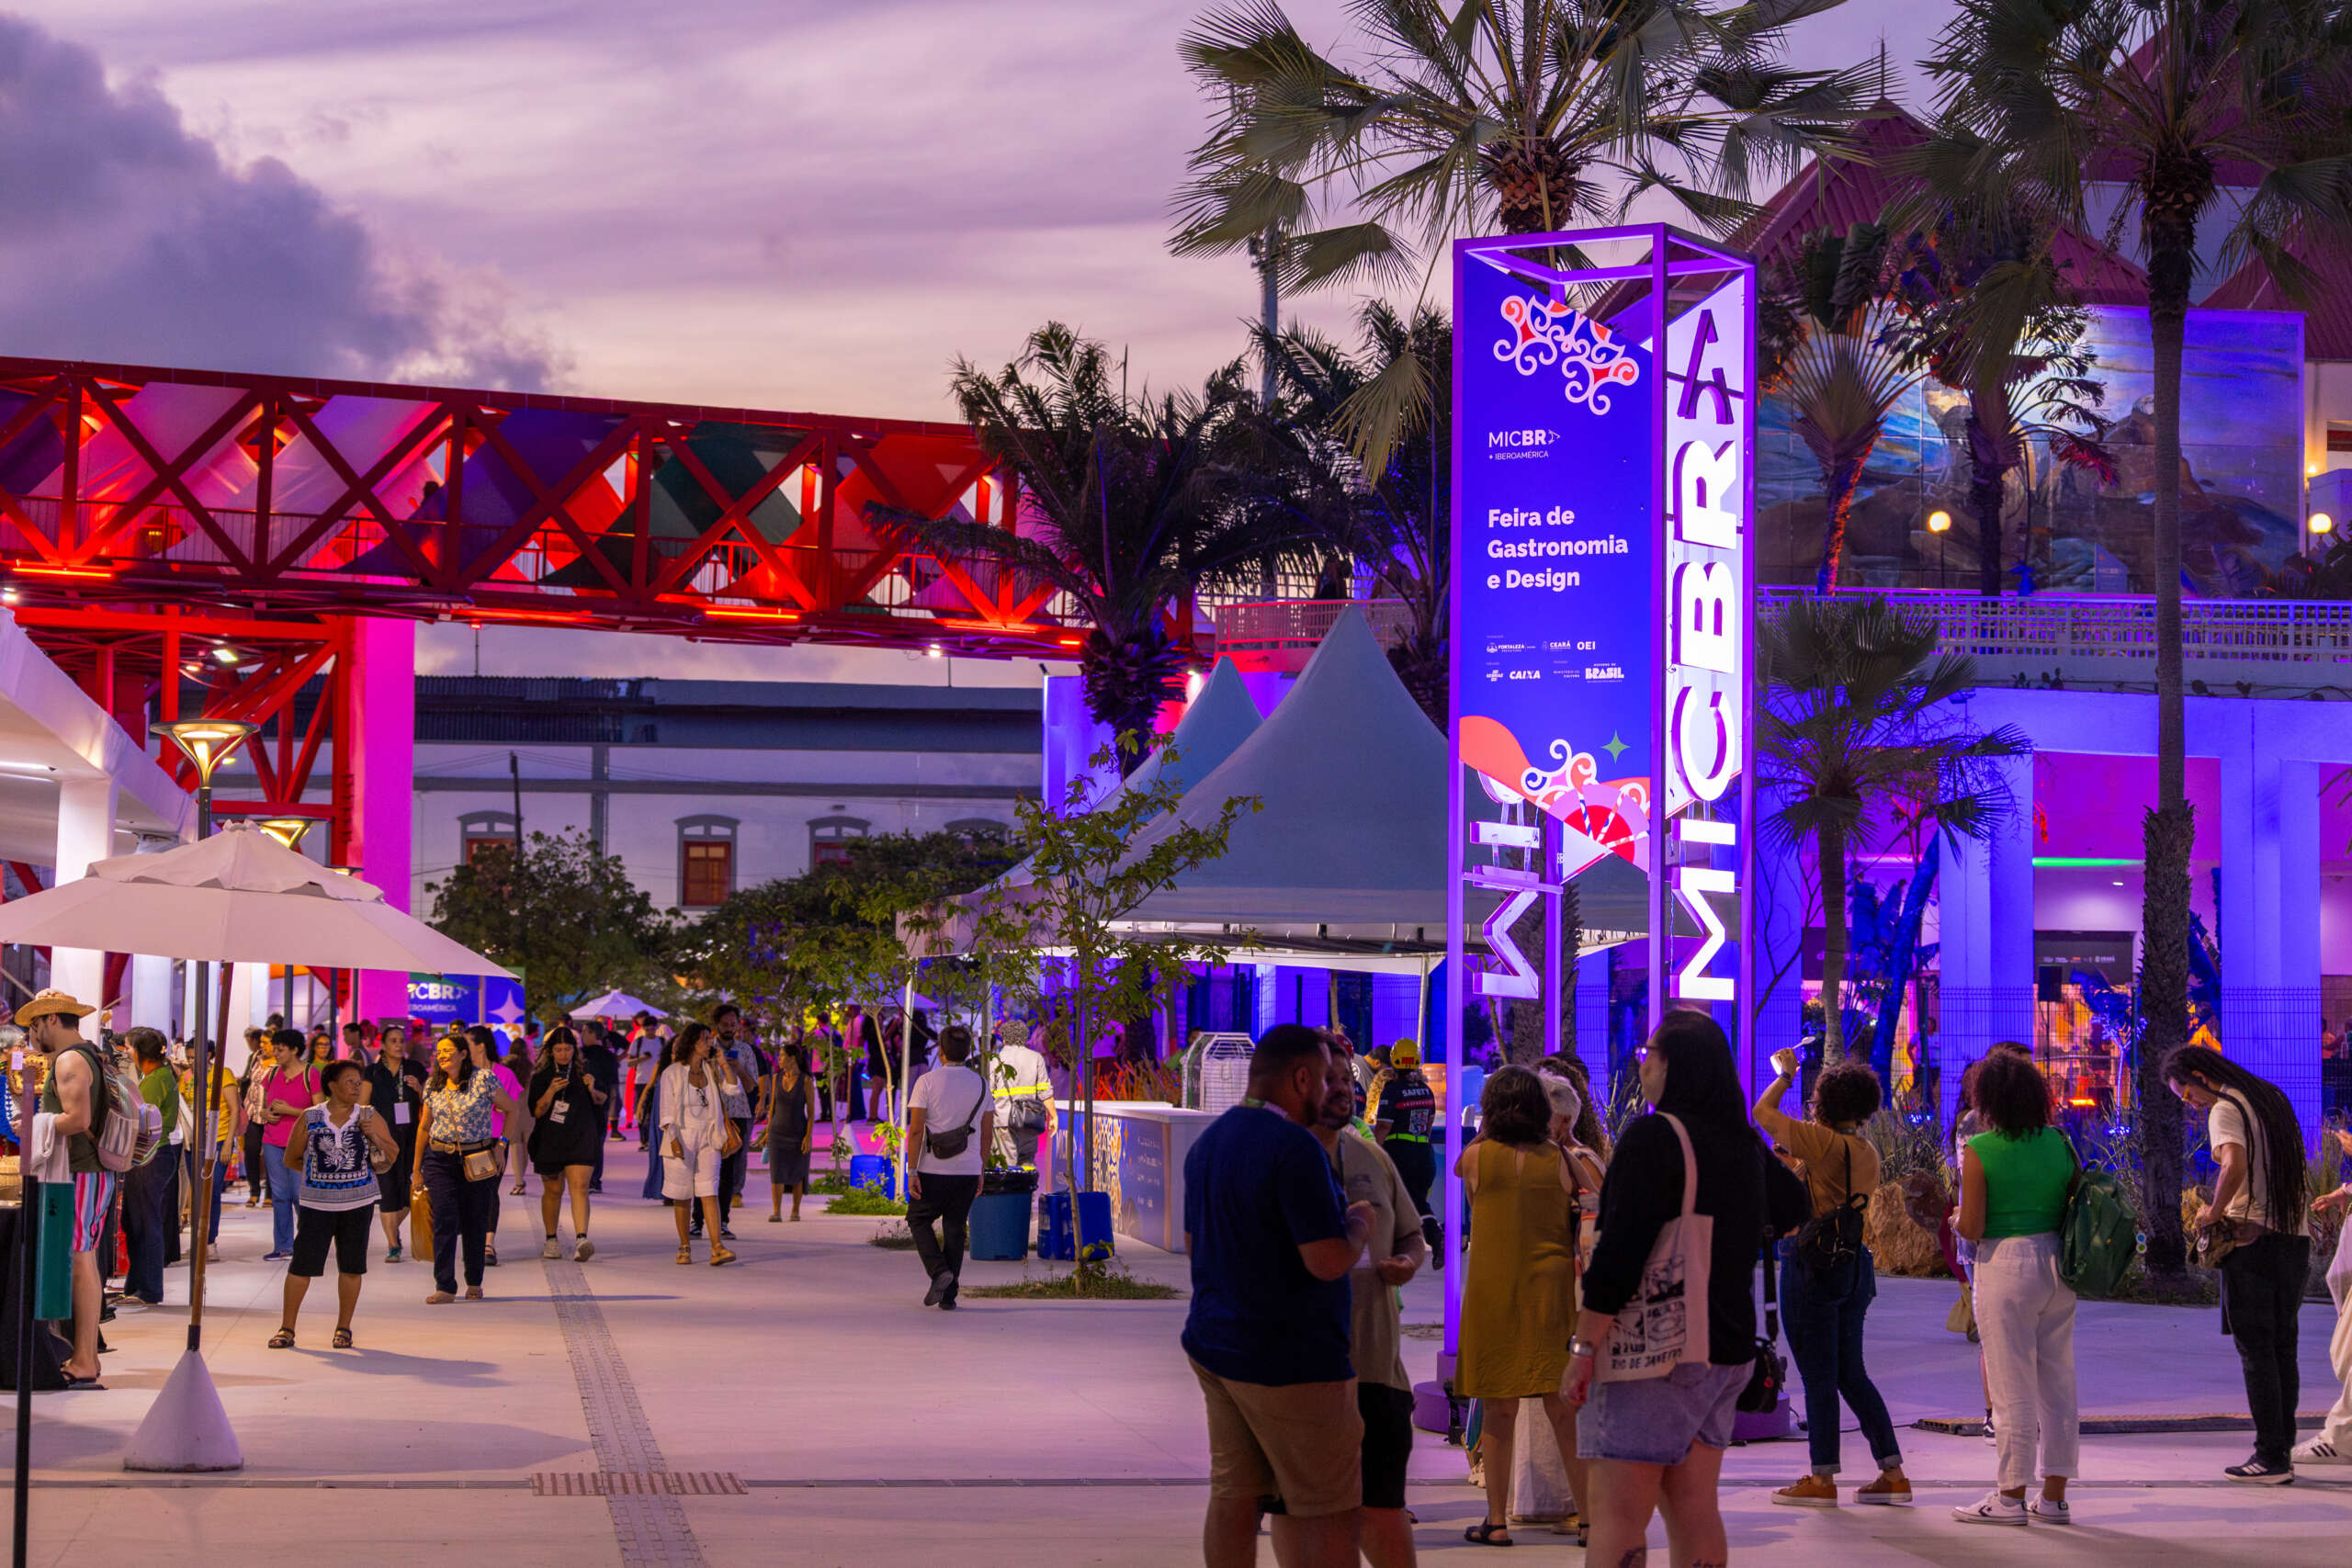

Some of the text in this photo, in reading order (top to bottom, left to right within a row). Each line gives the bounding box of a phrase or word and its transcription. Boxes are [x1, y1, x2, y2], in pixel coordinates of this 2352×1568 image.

[1488, 506, 1575, 527] Feira de
[1487, 534, 1628, 558] Gastronomia
[1487, 568, 1580, 592] e Design
[1577, 641, 1596, 650] OEI
[1510, 670, 1541, 680] CAIXA
[1585, 667, 1624, 680] BRASIL
